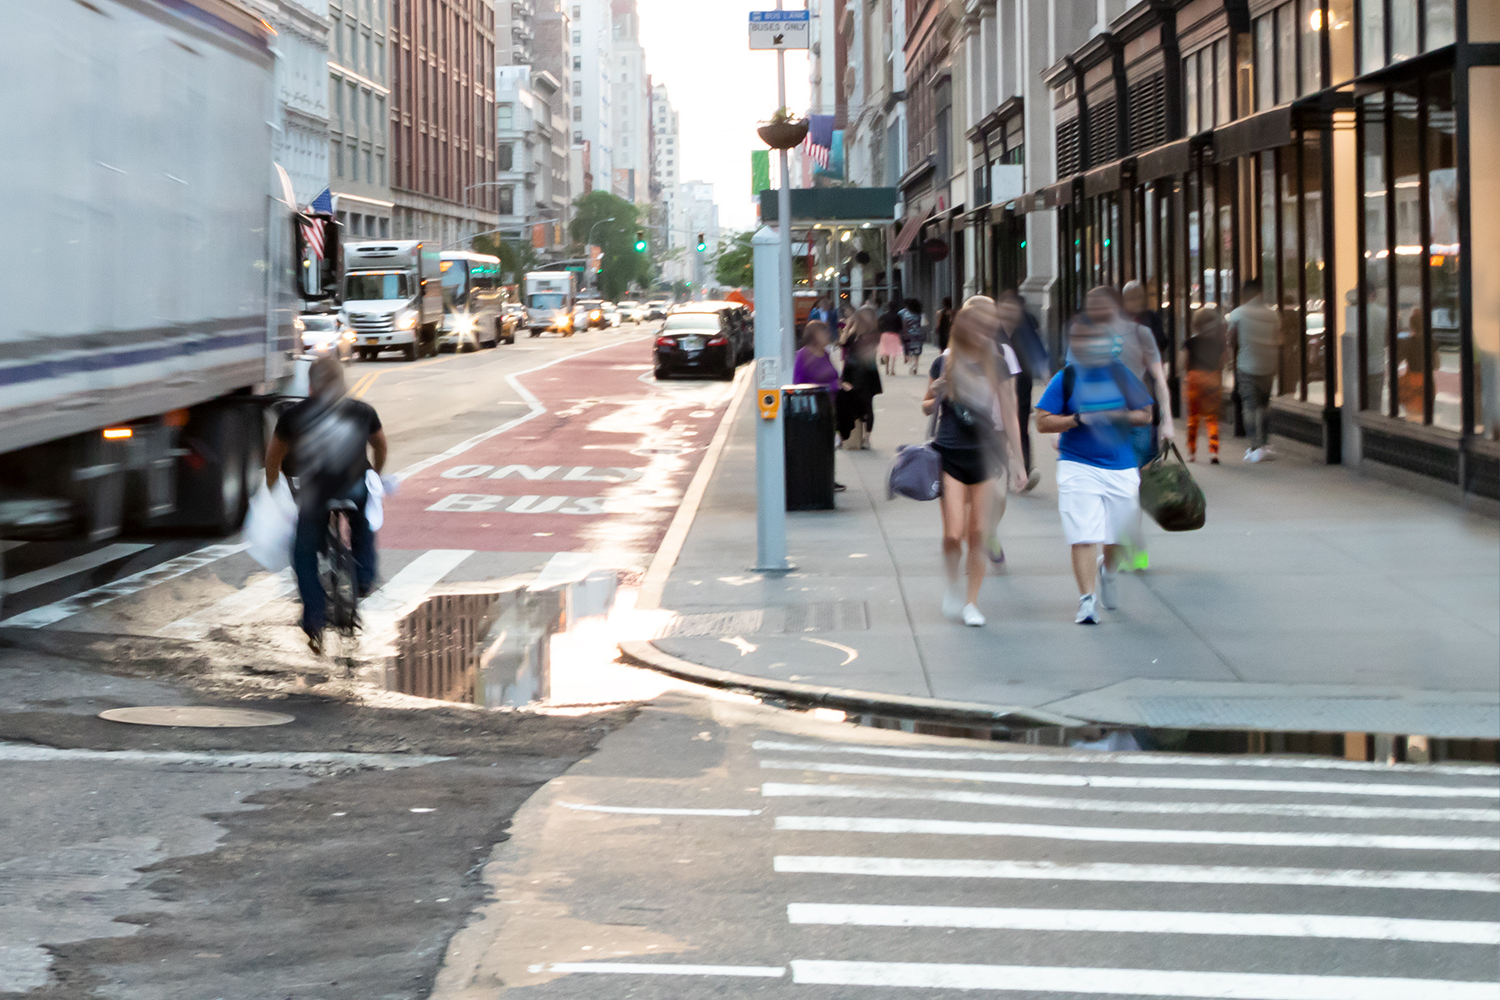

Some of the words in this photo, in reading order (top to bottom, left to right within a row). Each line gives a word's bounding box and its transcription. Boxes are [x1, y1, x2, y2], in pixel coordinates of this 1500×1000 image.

[764, 12, 781, 20] BUS
[783, 11, 805, 20] LANE
[751, 22, 781, 31] BUSES
[784, 22, 807, 31] ONLY
[440, 464, 647, 482] ONLY
[424, 493, 608, 515] BUS
